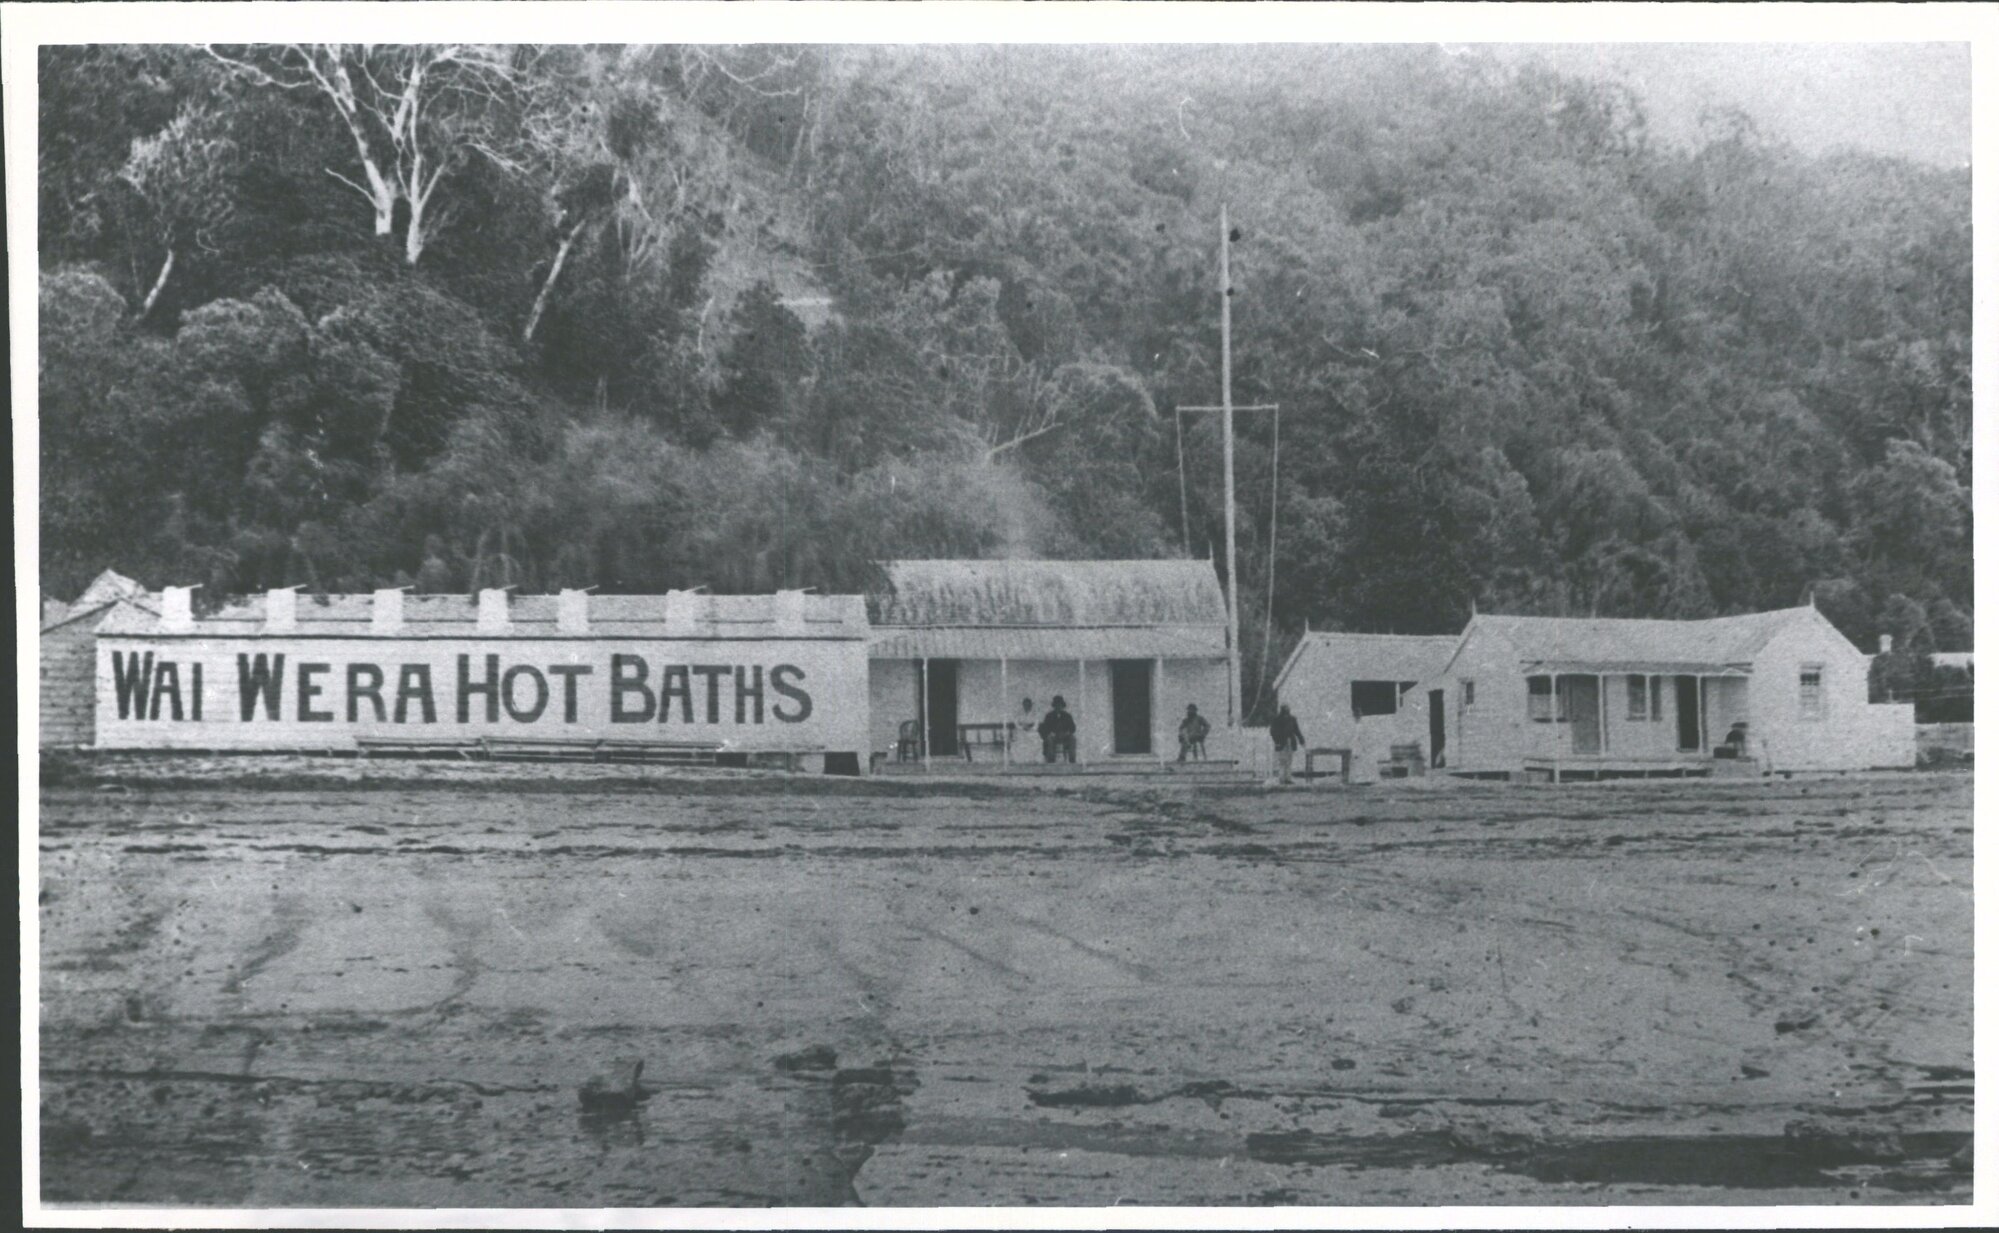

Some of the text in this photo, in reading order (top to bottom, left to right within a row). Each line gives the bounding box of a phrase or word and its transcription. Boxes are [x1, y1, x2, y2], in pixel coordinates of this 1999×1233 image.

[111, 650, 813, 723] WAI WERA HOT BATHS
